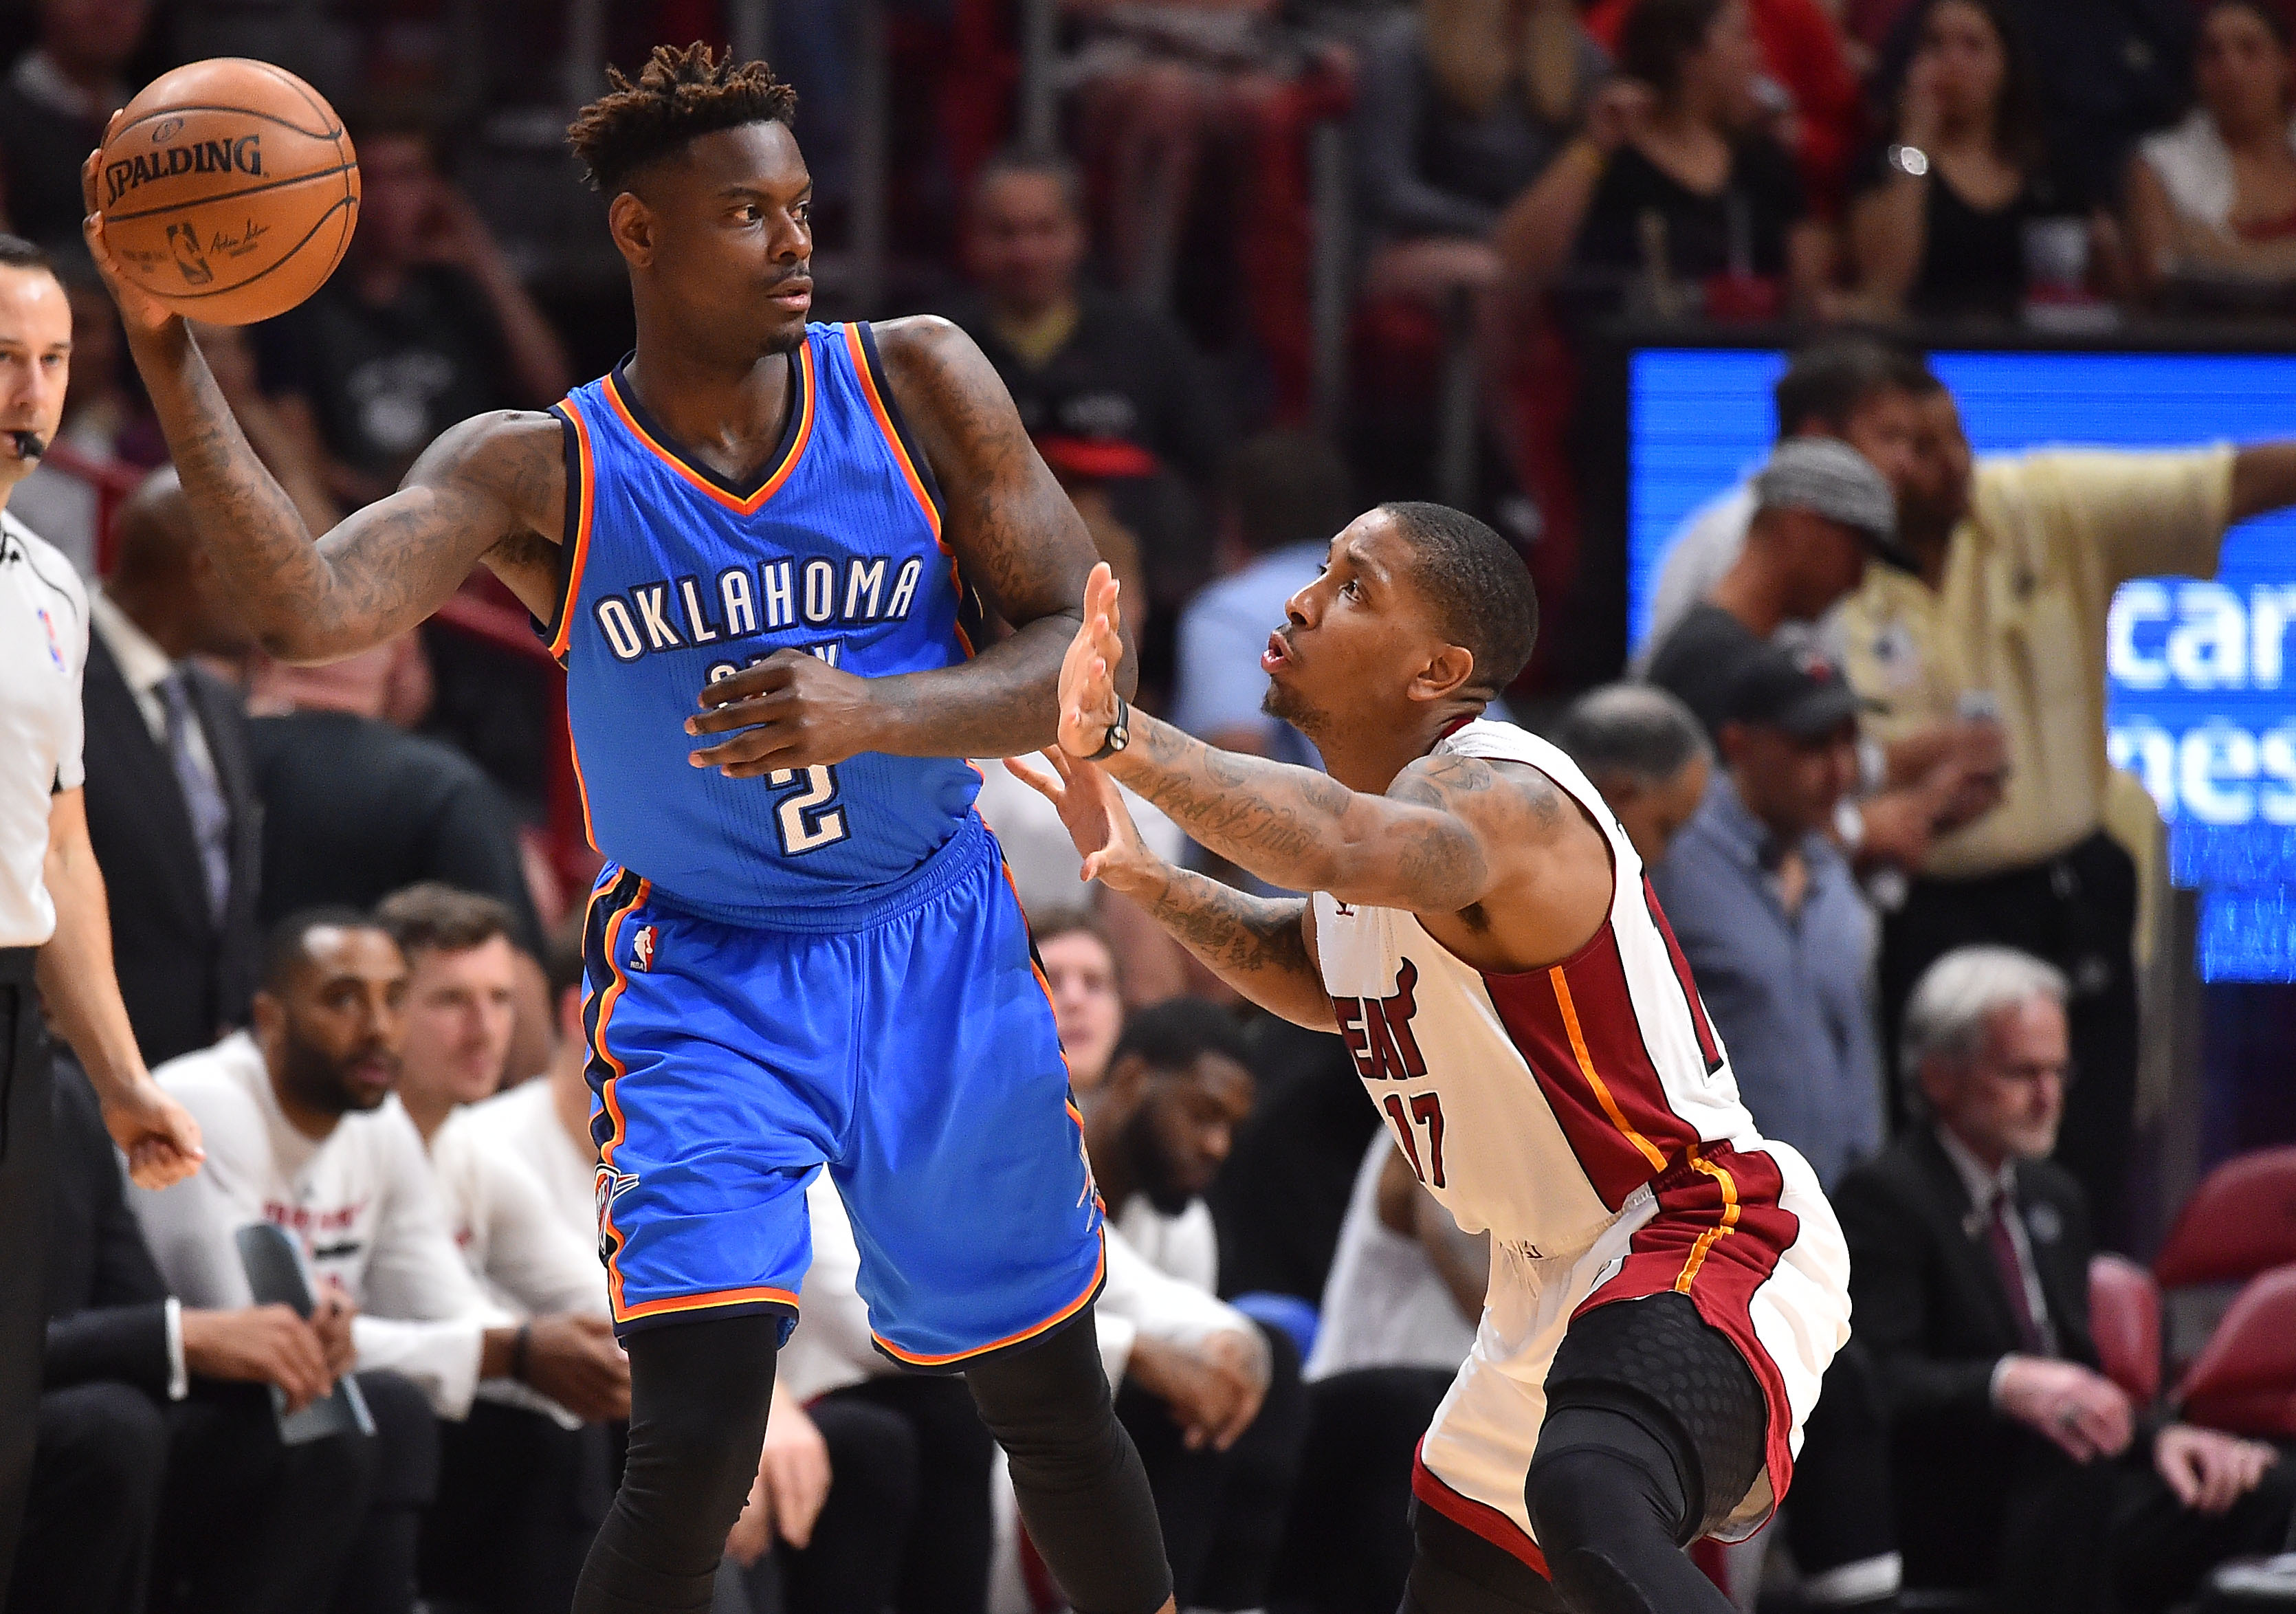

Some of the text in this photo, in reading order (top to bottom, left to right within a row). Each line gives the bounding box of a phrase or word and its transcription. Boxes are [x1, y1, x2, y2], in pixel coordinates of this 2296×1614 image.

[105, 133, 261, 208] SPALDING
[593, 556, 923, 663] OKLAHOMA
[769, 764, 848, 856] 2
[630, 960, 644, 971] NBA
[1331, 956, 1428, 1080] EAT
[1382, 1092, 1446, 1189] 17
